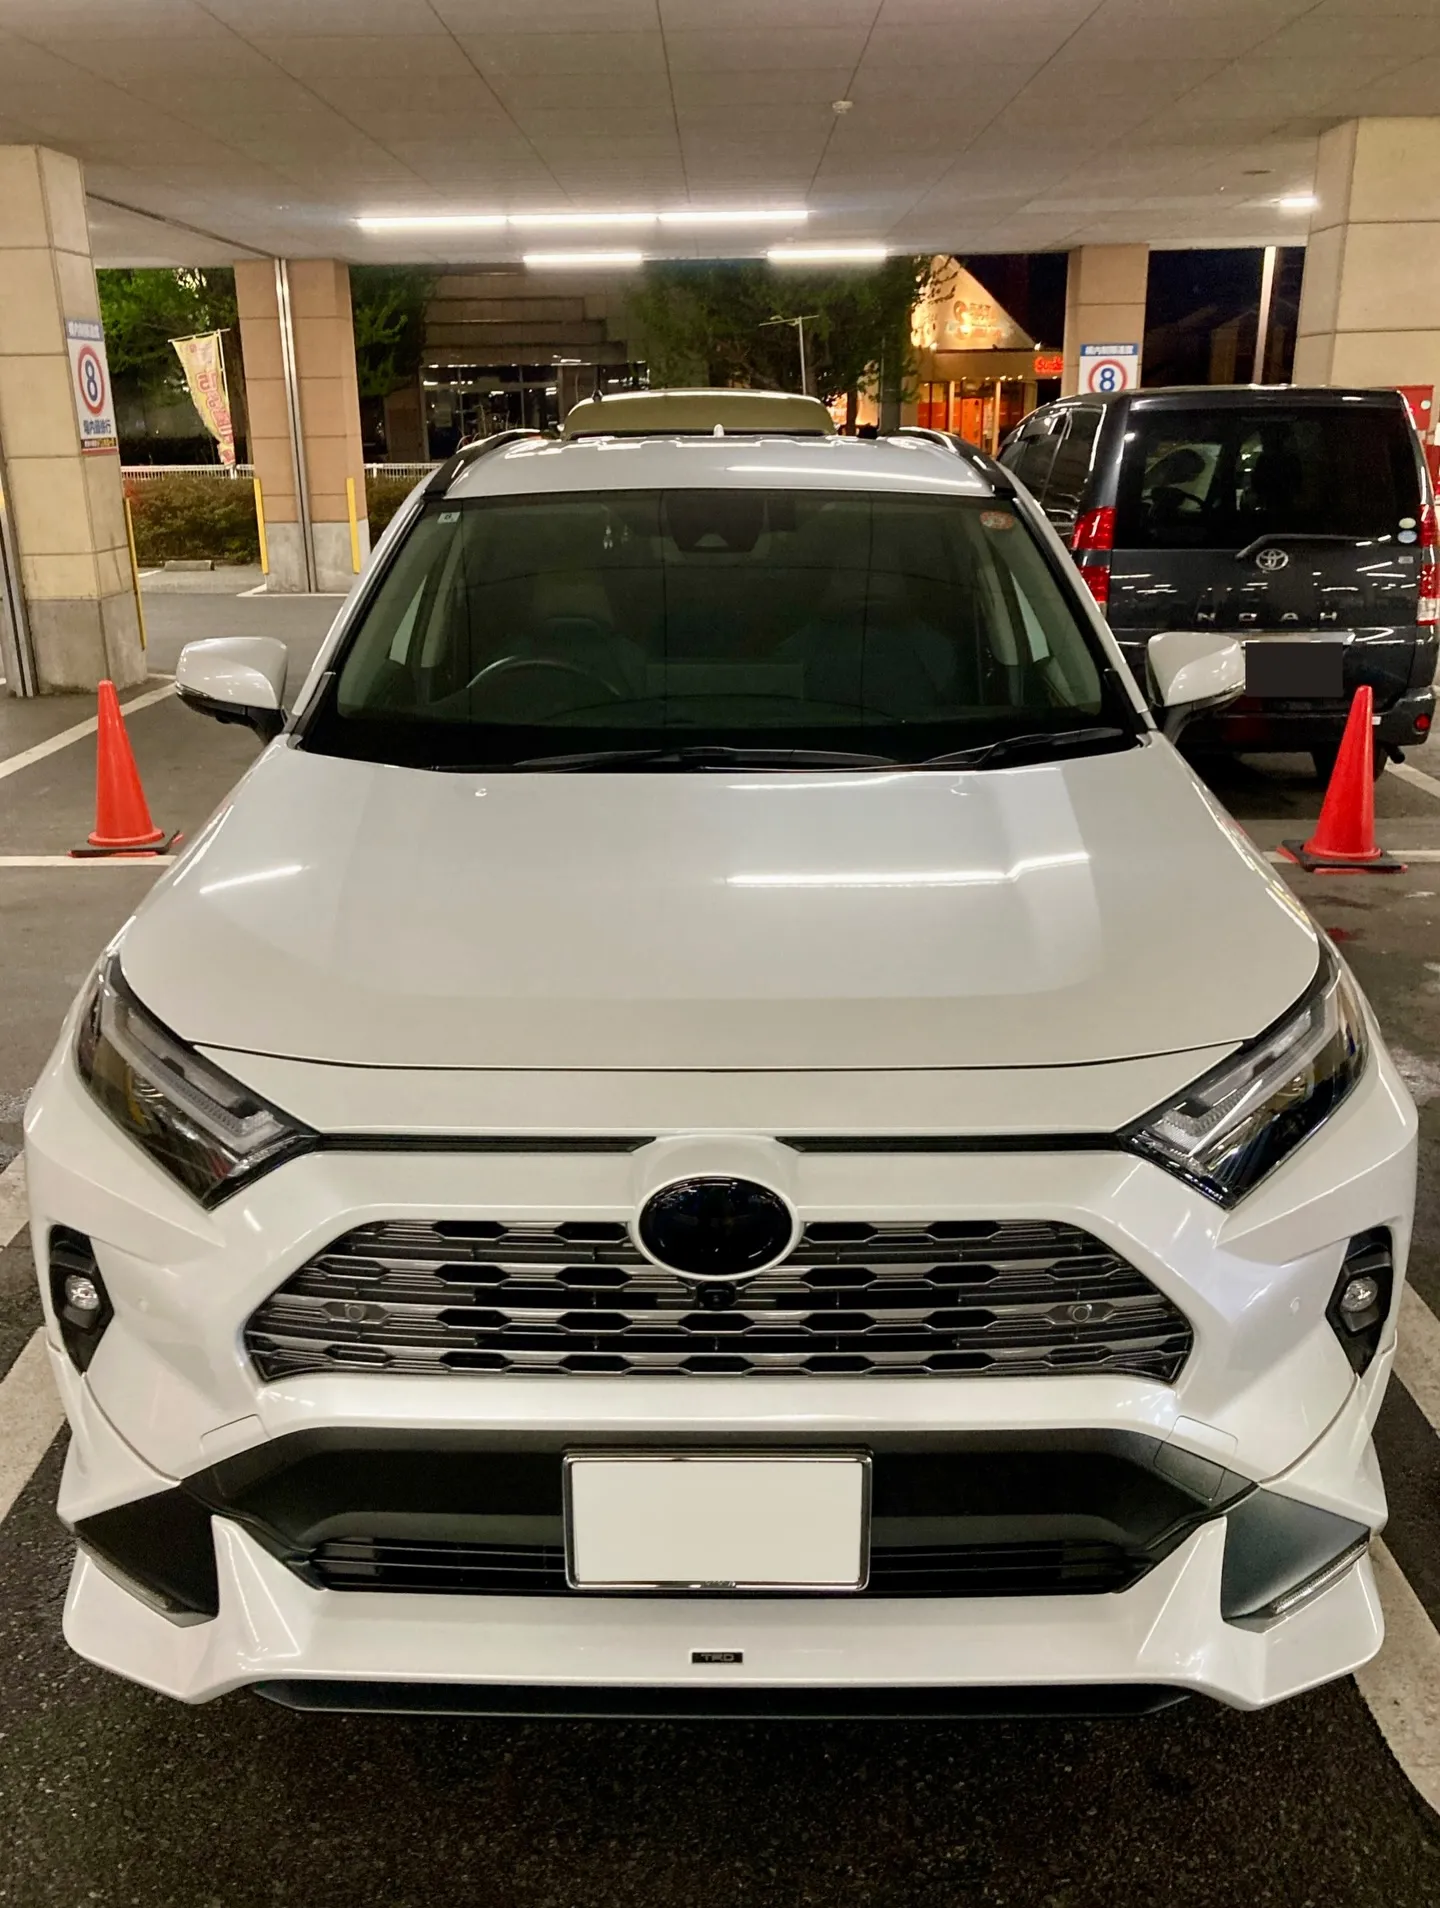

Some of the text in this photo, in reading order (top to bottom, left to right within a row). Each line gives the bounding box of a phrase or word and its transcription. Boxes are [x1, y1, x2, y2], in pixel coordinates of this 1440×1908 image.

[85, 360, 97, 401] 8
[1100, 367, 1115, 392] 8
[1197, 612, 1337, 622] NOAH
